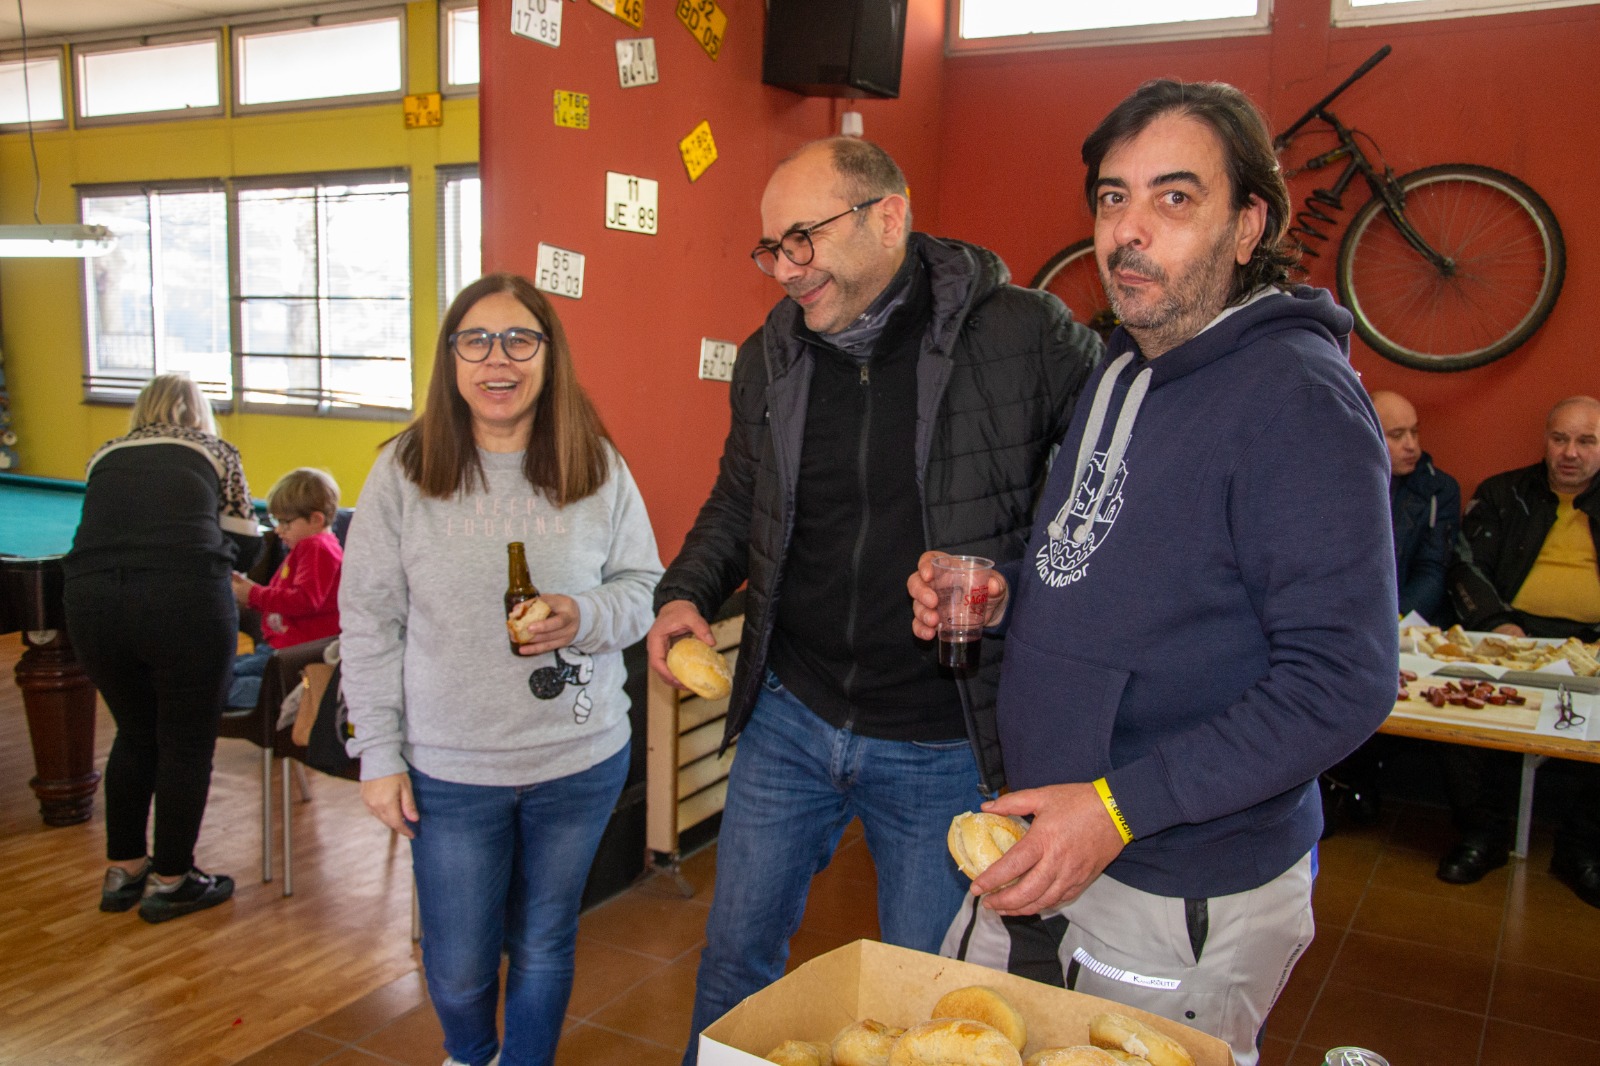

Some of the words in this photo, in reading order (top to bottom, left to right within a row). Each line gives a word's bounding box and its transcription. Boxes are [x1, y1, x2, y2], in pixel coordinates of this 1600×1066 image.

[552, 251, 570, 272] 65
[475, 497, 536, 516] KEEP
[447, 515, 566, 537] LOOKING
[1035, 544, 1051, 581] Vila
[1045, 563, 1090, 588] Maior
